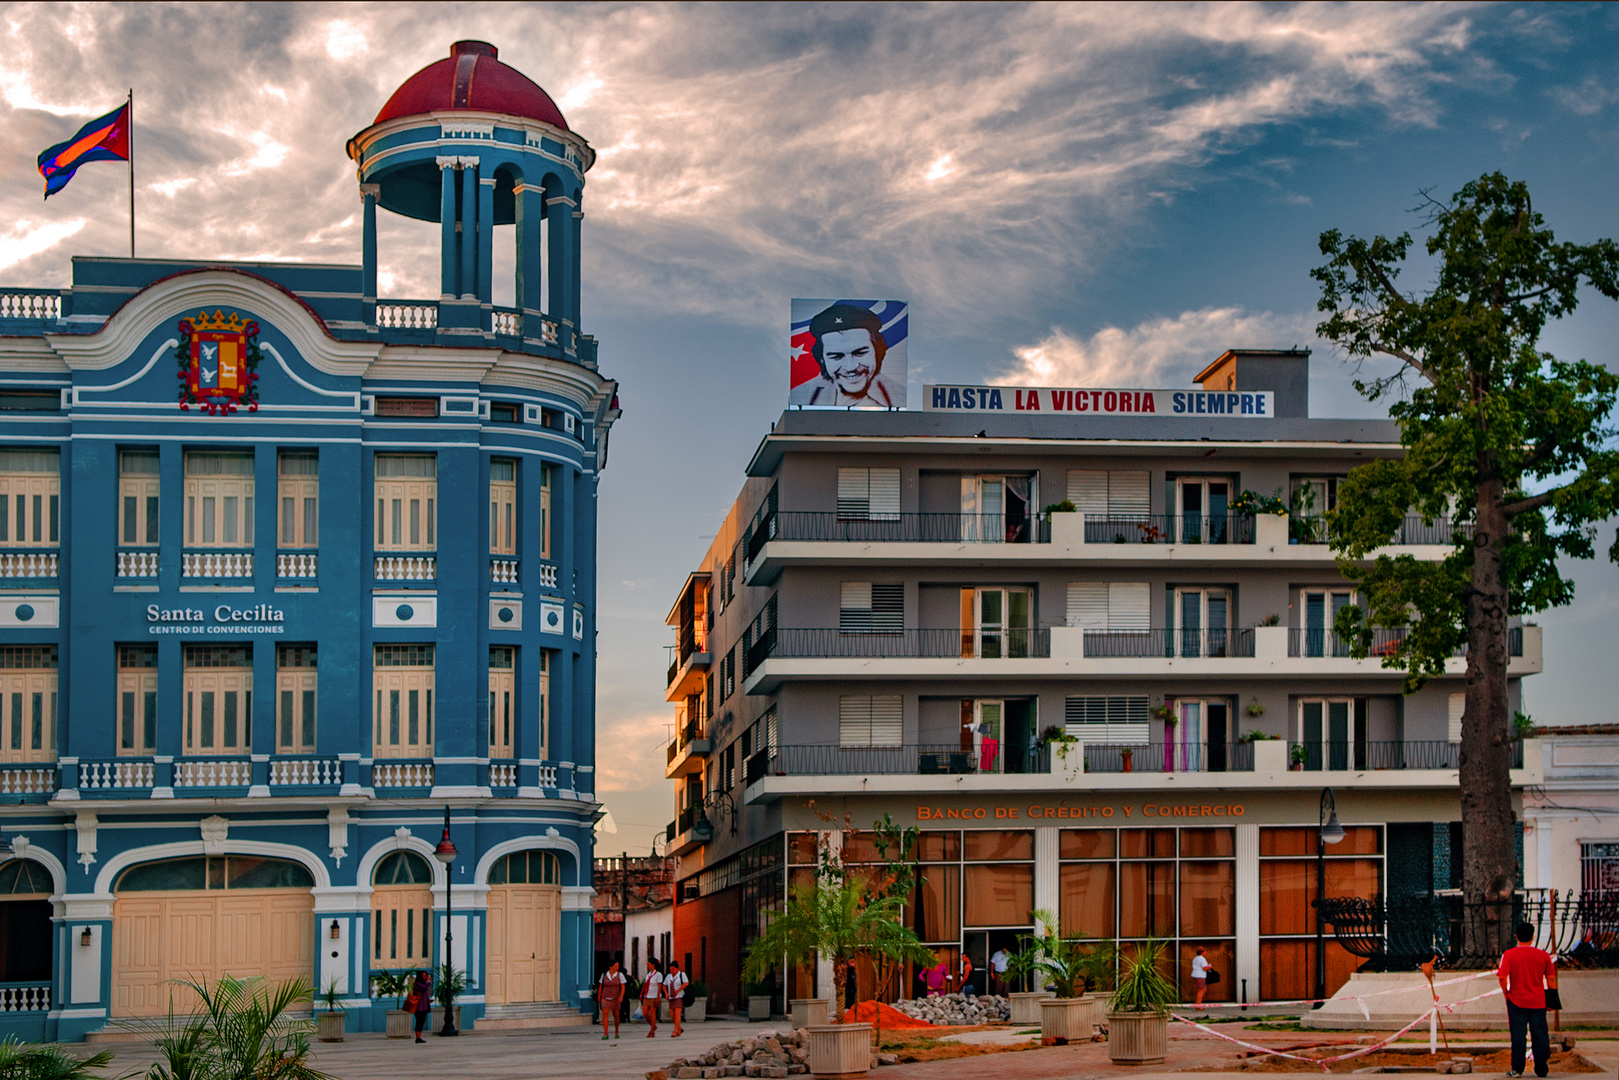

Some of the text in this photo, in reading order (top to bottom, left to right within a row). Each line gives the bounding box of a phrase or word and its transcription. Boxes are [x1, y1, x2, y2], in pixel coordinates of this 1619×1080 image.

[932, 387, 1266, 415] HASTA LA VICTORIA SIEMPRE
[147, 604, 284, 622] Santa Cecilia
[149, 625, 284, 634] CENTRO DE CONVENCIONES
[916, 801, 1245, 820] BANCO DE CRÉDITO Y COMERCIO
[460, 865, 465, 874] 1
